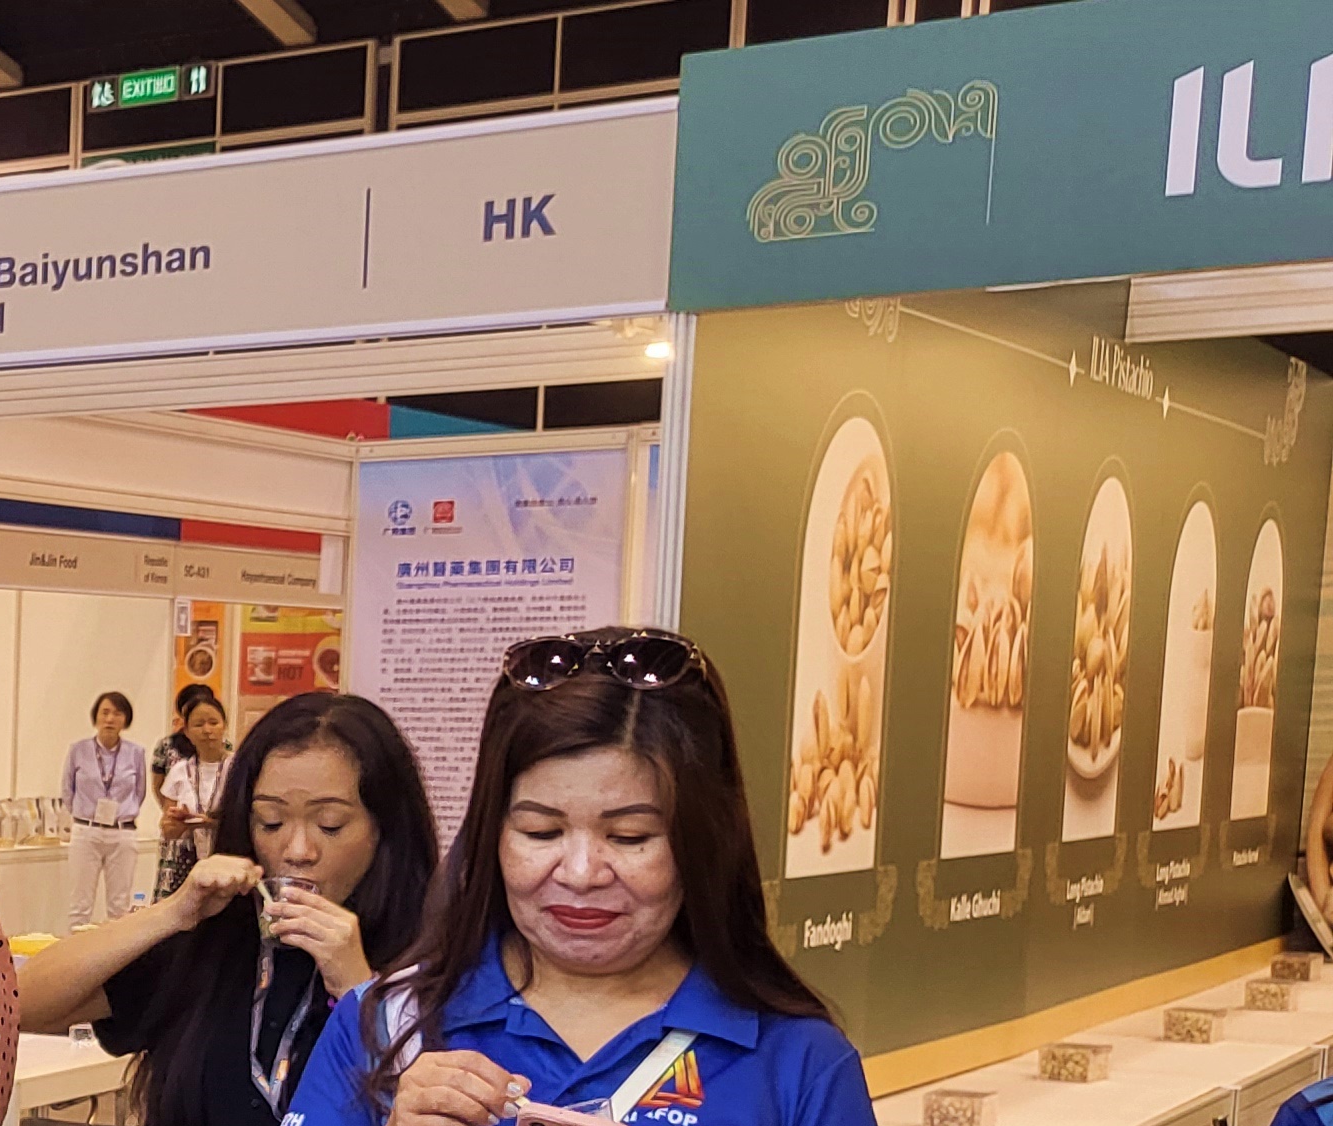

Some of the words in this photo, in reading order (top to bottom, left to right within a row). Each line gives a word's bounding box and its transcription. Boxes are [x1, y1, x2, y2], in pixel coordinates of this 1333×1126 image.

[122, 79, 153, 100] EXIT
[482, 193, 557, 242] HK
[1090, 335, 1110, 386] ILIA
[59, 555, 78, 570] Food
[803, 910, 853, 951] Fandoghi
